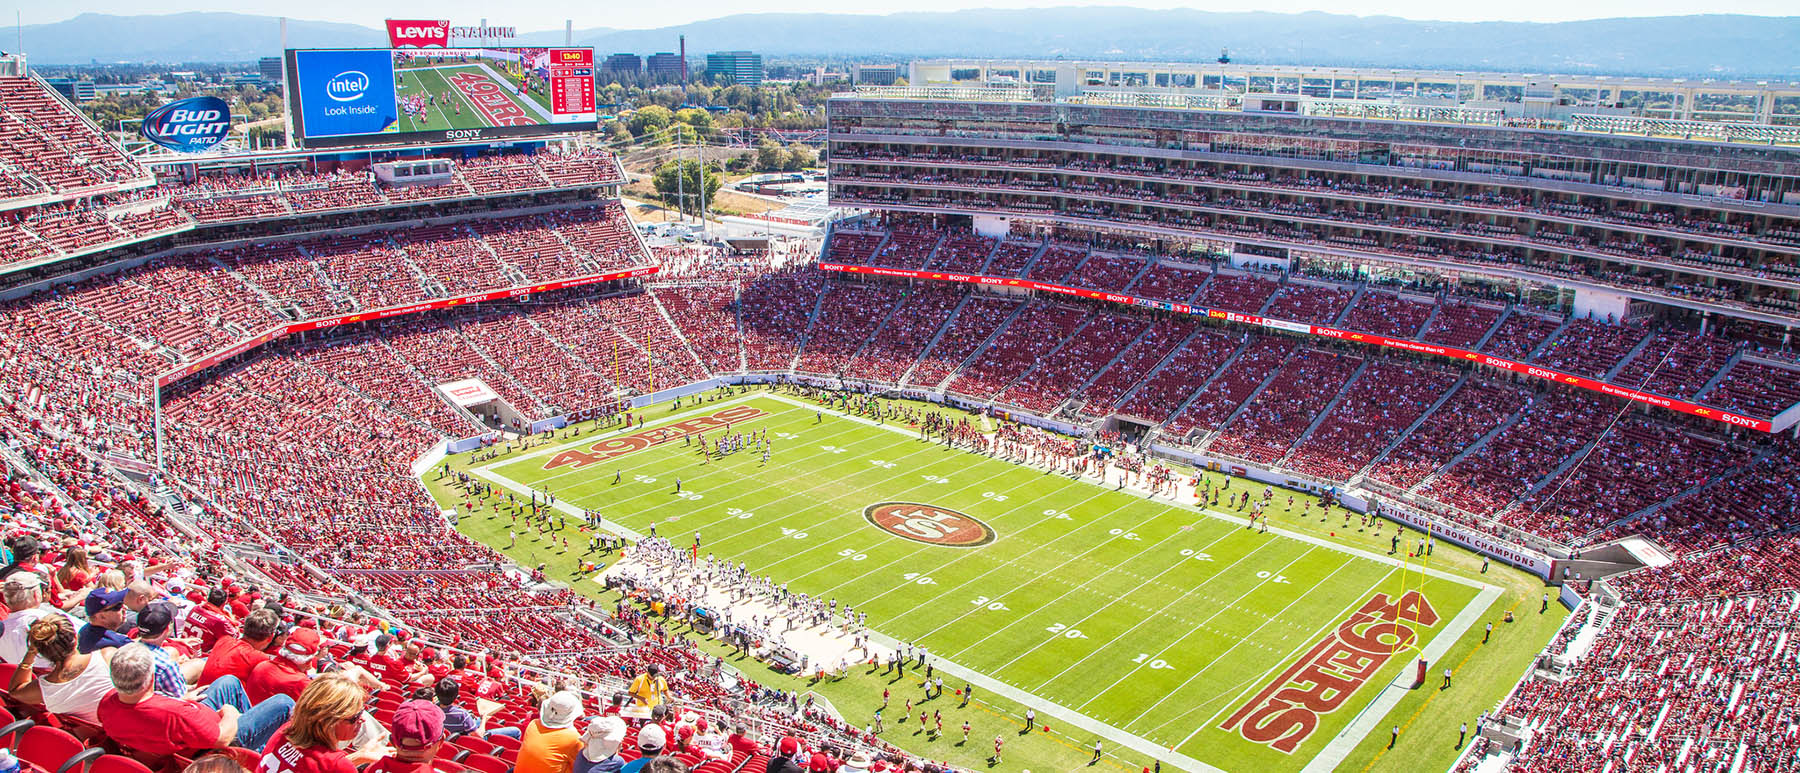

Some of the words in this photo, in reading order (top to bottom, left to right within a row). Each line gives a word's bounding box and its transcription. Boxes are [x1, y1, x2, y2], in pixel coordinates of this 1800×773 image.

[452, 26, 516, 38] STADIUM
[332, 77, 363, 92] intel
[169, 109, 221, 123] BUD
[325, 106, 348, 116] Look
[349, 105, 377, 115] Inside
[159, 122, 229, 136] LIGHT
[446, 129, 481, 139] SONY
[189, 136, 217, 145] PATIO
[631, 268, 651, 277] SONY
[510, 288, 532, 296] SONY
[1106, 294, 1128, 303] SONY
[465, 294, 488, 304] SONY
[315, 318, 342, 328] SONY
[1317, 327, 1344, 338] SONY
[1486, 357, 1514, 369] SONY
[168, 368, 188, 382] SONY
[1528, 367, 1557, 380] SONY
[1565, 377, 1579, 385] 4K
[1695, 408, 1711, 416] 4K
[1722, 413, 1760, 428] SONY
[542, 405, 769, 469] 49ERS
[1413, 517, 1442, 533] SUPER
[1445, 529, 1471, 545] BOWL
[1475, 540, 1535, 567] CHAMPIONS
[837, 548, 867, 561] 50
[904, 572, 933, 585] 40
[971, 596, 1004, 611] 30
[1046, 623, 1081, 639] 20
[1132, 653, 1167, 669] 10
[1217, 590, 1441, 755] 49ERS
[278, 741, 304, 767] GORE
